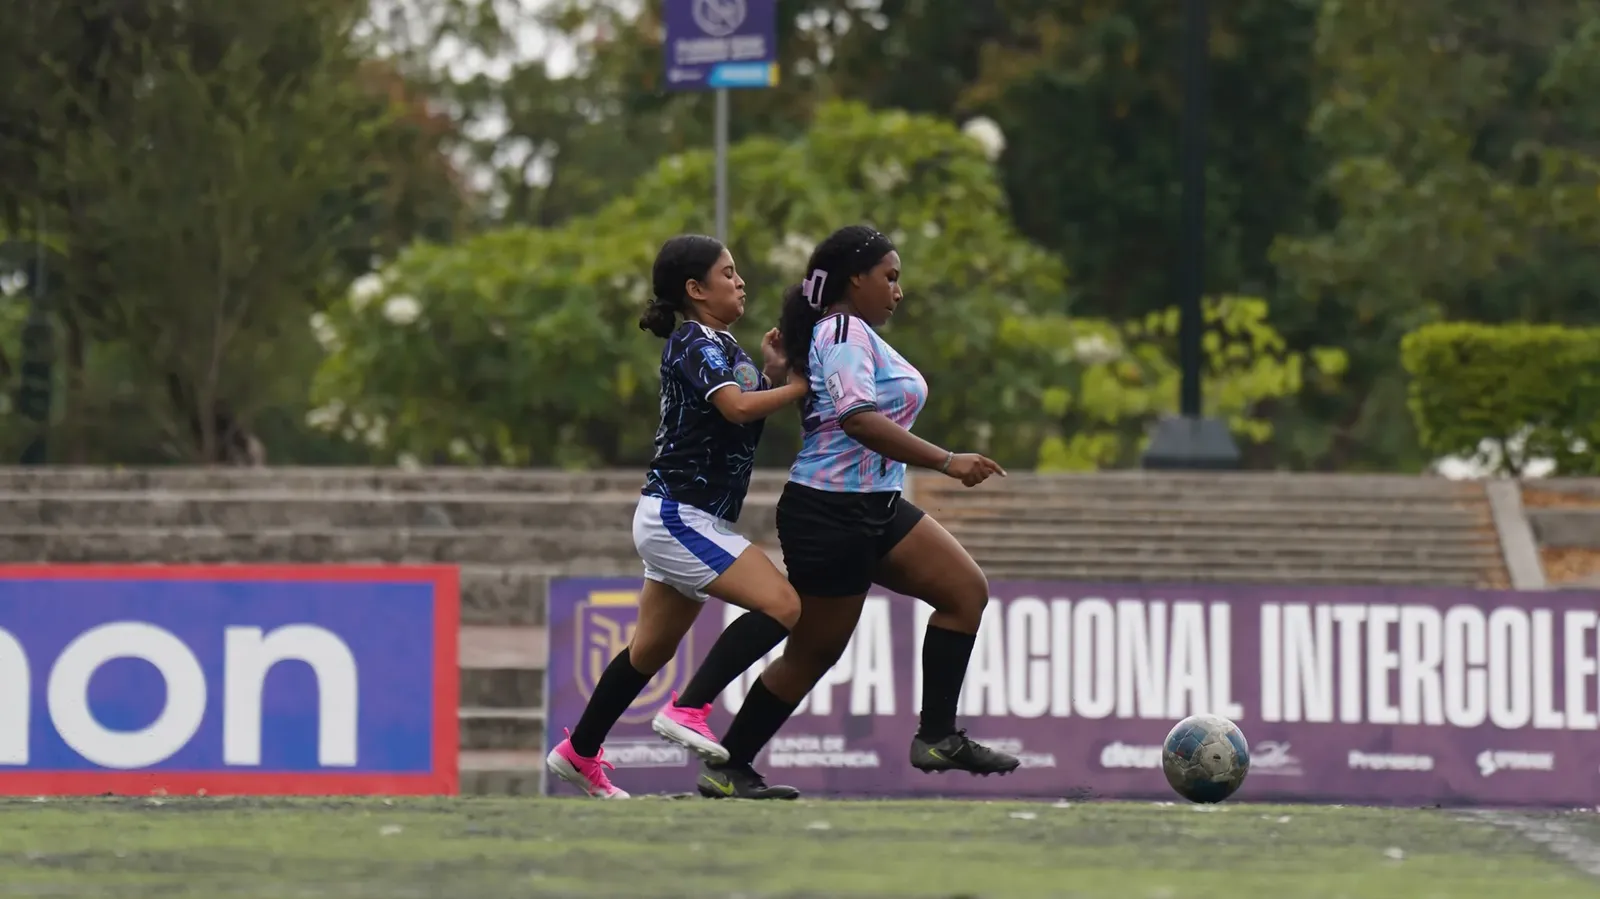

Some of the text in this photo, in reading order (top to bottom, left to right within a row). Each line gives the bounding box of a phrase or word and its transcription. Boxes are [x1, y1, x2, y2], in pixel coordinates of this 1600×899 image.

[0, 620, 358, 769] on
[722, 596, 896, 717] CPA
[1260, 602, 1600, 729] INTERCOLE
